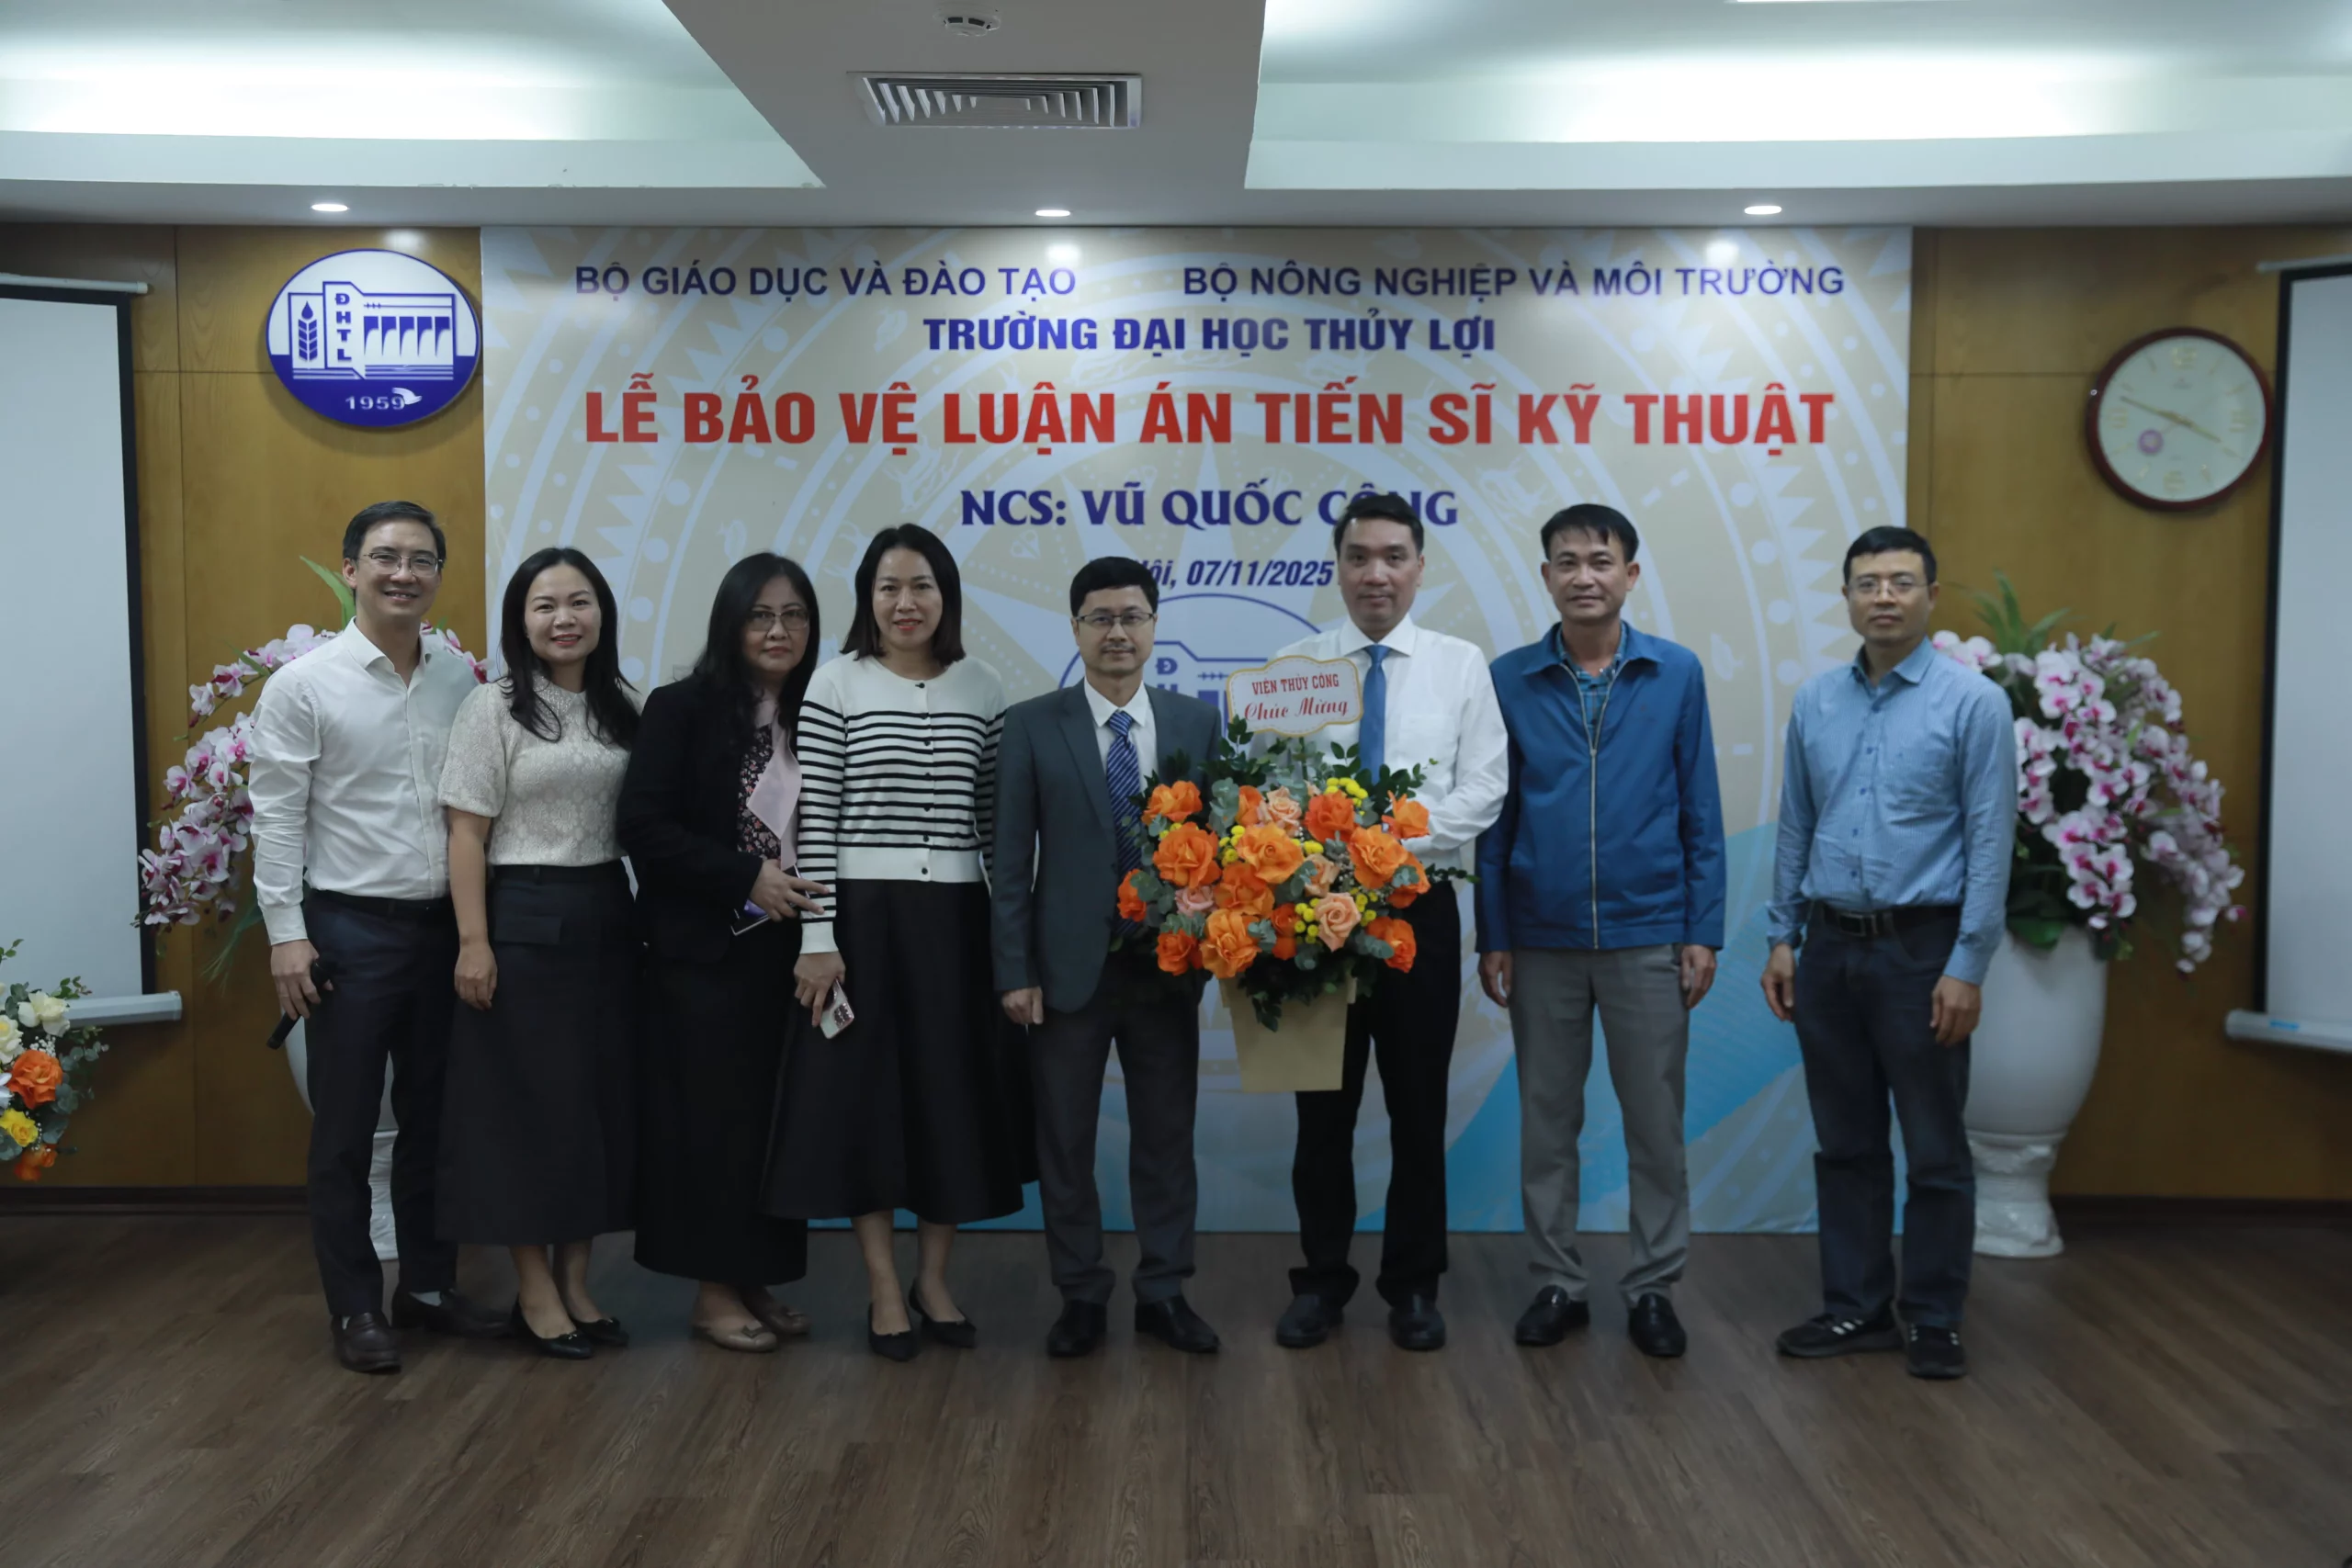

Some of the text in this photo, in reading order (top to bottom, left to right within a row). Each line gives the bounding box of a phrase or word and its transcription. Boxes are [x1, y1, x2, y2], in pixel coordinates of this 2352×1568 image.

[576, 259, 1076, 302] BỘ GIÁO DỤC VÀ ĐÀO TẠO
[1184, 259, 1845, 303] BỘ NÔNG NGHIỆP VÀ MÔI TRƯỜNG
[923, 308, 1496, 359] TRƯỜNG ĐẠI HỌC THỦY LỢI
[345, 396, 405, 411] 1959
[586, 373, 1835, 457] LỄ BẢO VỆ LUẬN ÁN TIẾN SĨ KỸ THUẬT
[960, 490, 1067, 526] NCS:
[1081, 480, 1146, 526] VŨ
[1161, 478, 1302, 532] QUỐC
[1186, 559, 1335, 588] 07/11/2025
